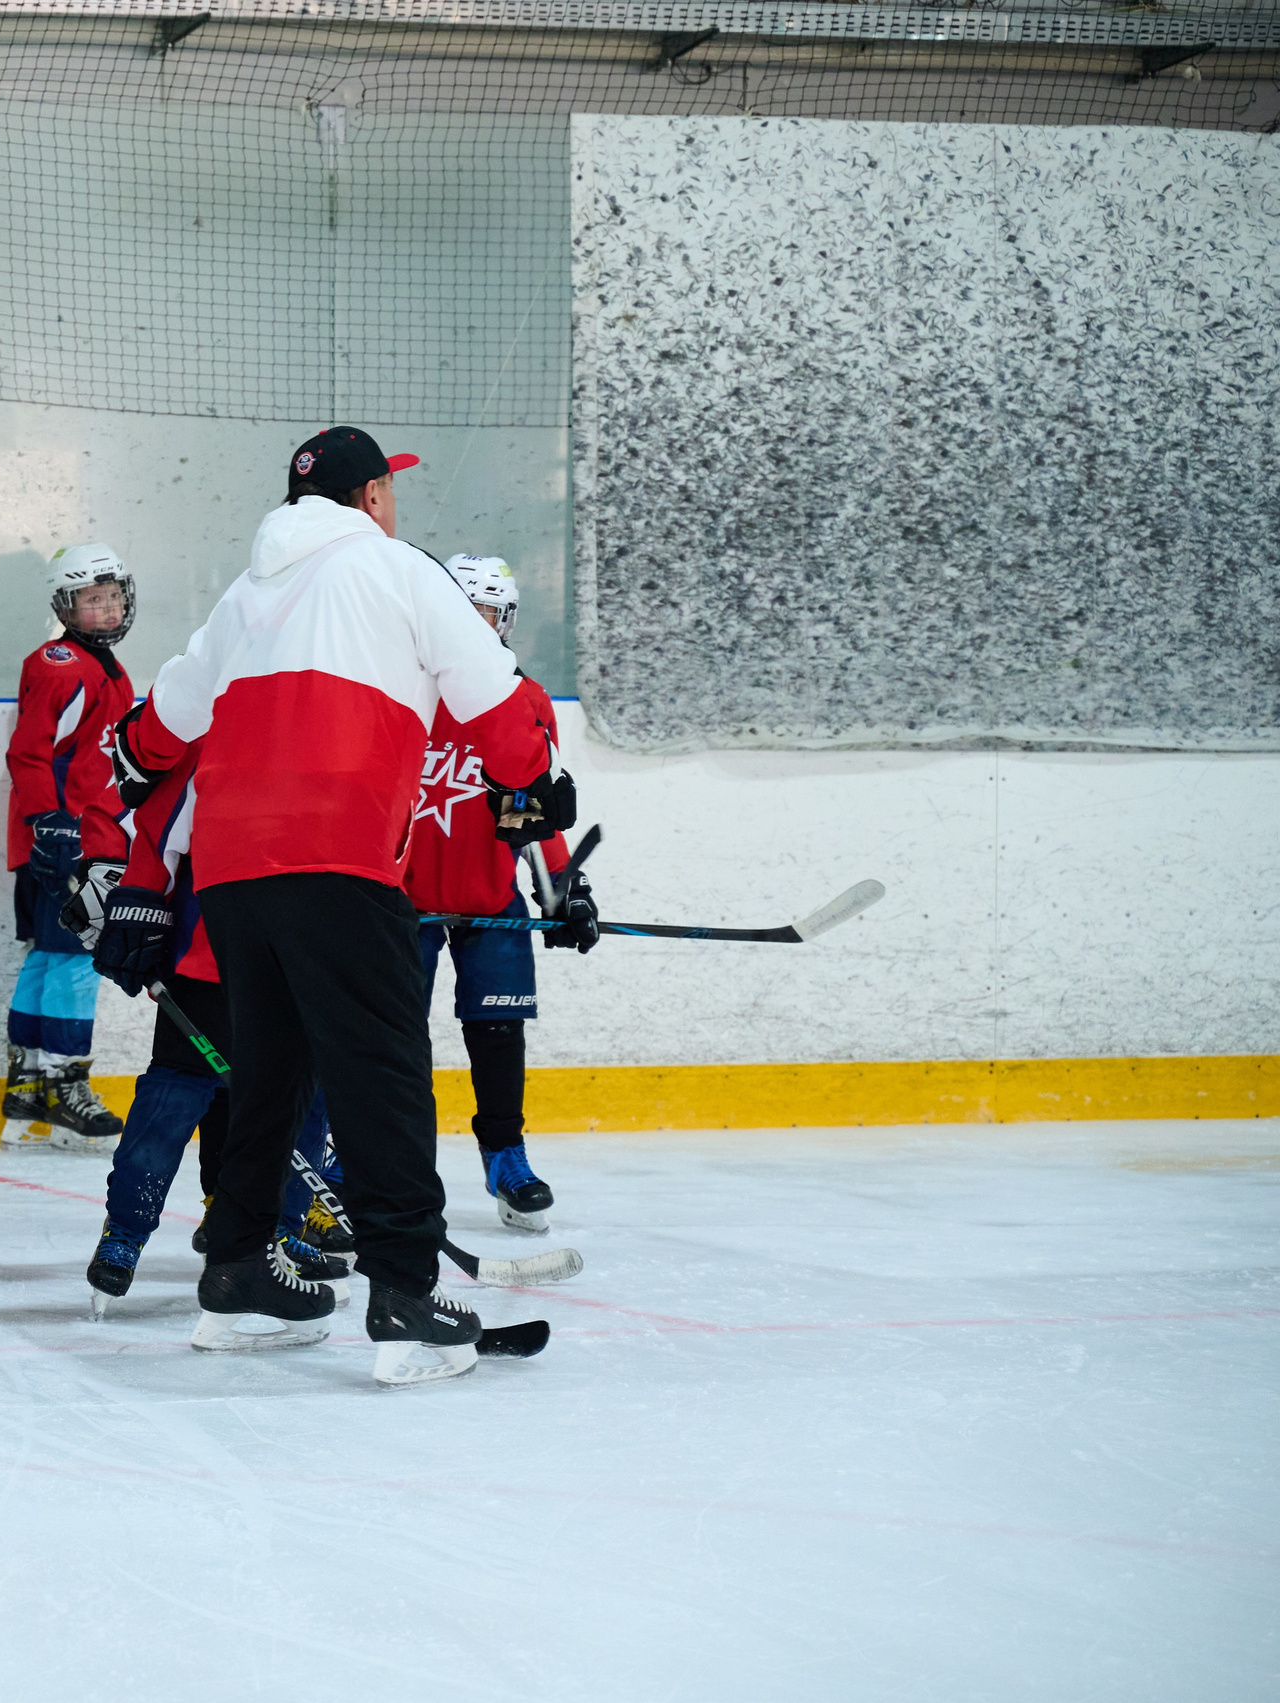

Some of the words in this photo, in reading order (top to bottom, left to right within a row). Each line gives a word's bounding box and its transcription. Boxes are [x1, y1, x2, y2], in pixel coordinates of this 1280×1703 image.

[109, 906, 175, 926] WARRIO
[481, 995, 538, 1006] BAUER
[290, 1149, 354, 1235] BAUE
